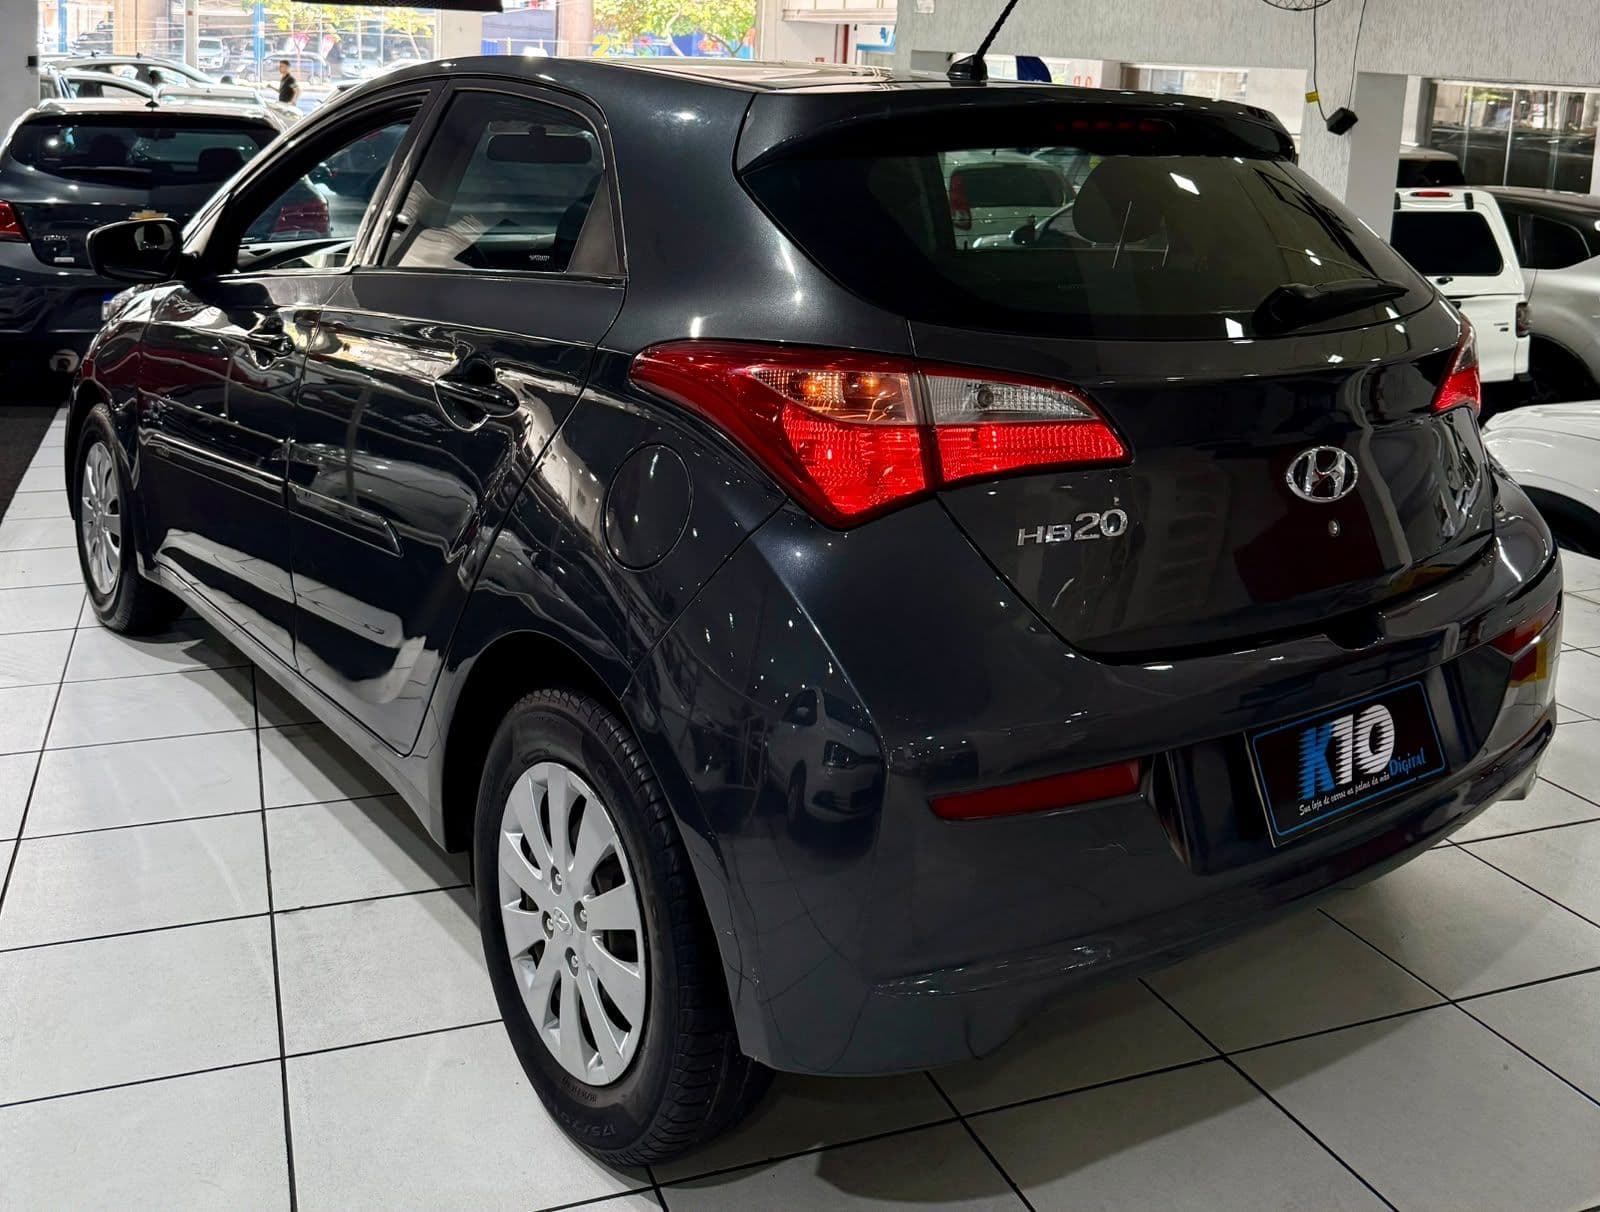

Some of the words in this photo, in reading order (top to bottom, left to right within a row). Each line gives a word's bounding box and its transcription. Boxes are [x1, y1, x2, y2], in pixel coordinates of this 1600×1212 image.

[1017, 508, 1128, 546] HB20
[1297, 704, 1395, 800] K10
[1389, 746, 1425, 776] Digital
[1299, 804, 1311, 816] Sua
[1311, 800, 1323, 811] loja
[1323, 795, 1330, 805] de
[1355, 780, 1371, 795] palma
[1371, 776, 1379, 786] da
[1379, 771, 1390, 783] mão
